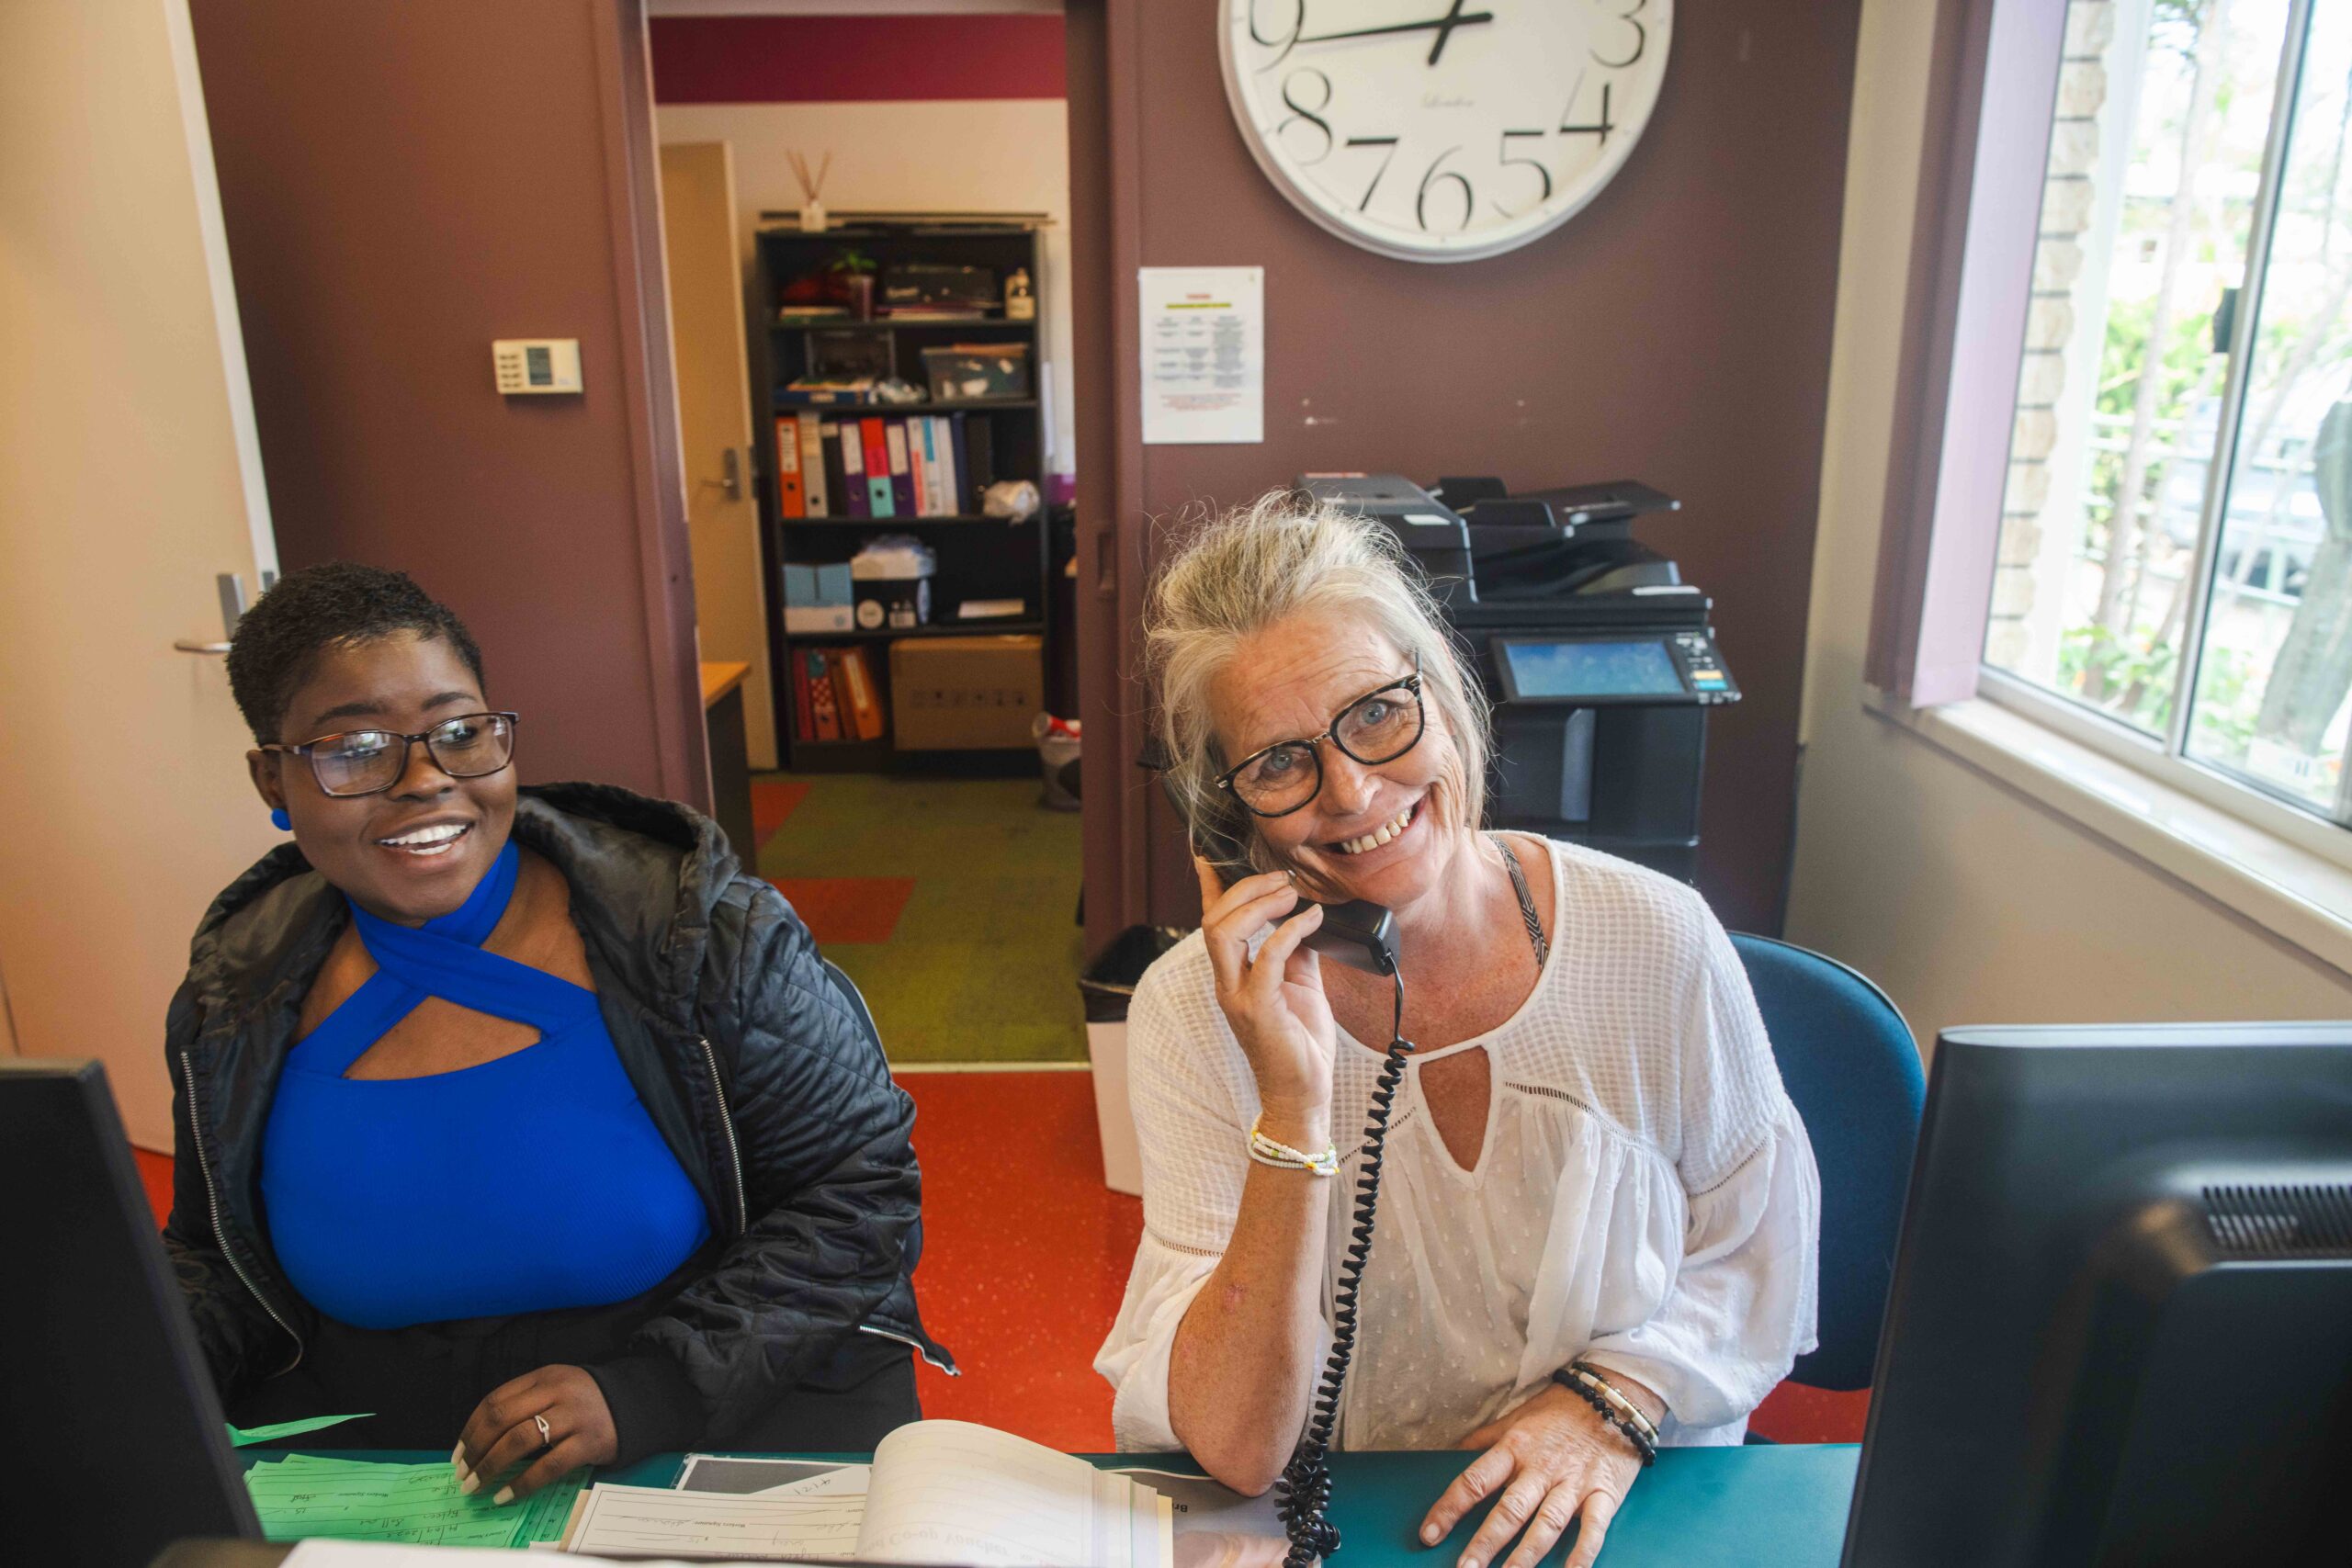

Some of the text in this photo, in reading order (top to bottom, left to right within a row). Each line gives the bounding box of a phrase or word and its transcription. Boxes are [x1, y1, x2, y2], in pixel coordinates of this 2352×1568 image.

[1250, 0, 1306, 74] 9
[1589, 0, 1647, 69] 3
[1277, 66, 1333, 165] 8
[1559, 67, 1614, 149] 4
[1346, 137, 1399, 212] 7
[1416, 144, 1474, 231] 6
[1491, 130, 1552, 219] 5
